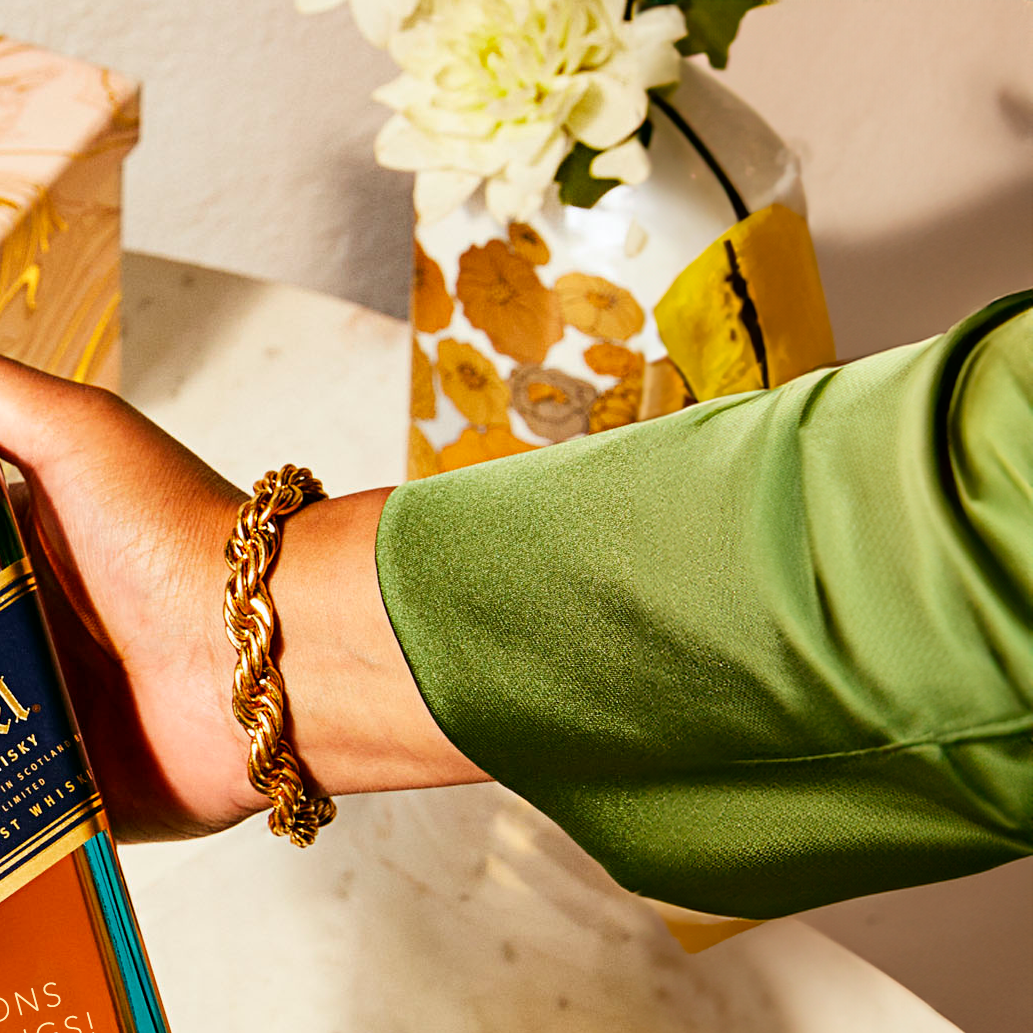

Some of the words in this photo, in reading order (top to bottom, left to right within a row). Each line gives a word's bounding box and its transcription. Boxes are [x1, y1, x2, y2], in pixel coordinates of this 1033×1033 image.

[0, 780, 15, 794] IN
[16, 740, 72, 782] SCOTLAND
[0, 777, 47, 813] LIMITED
